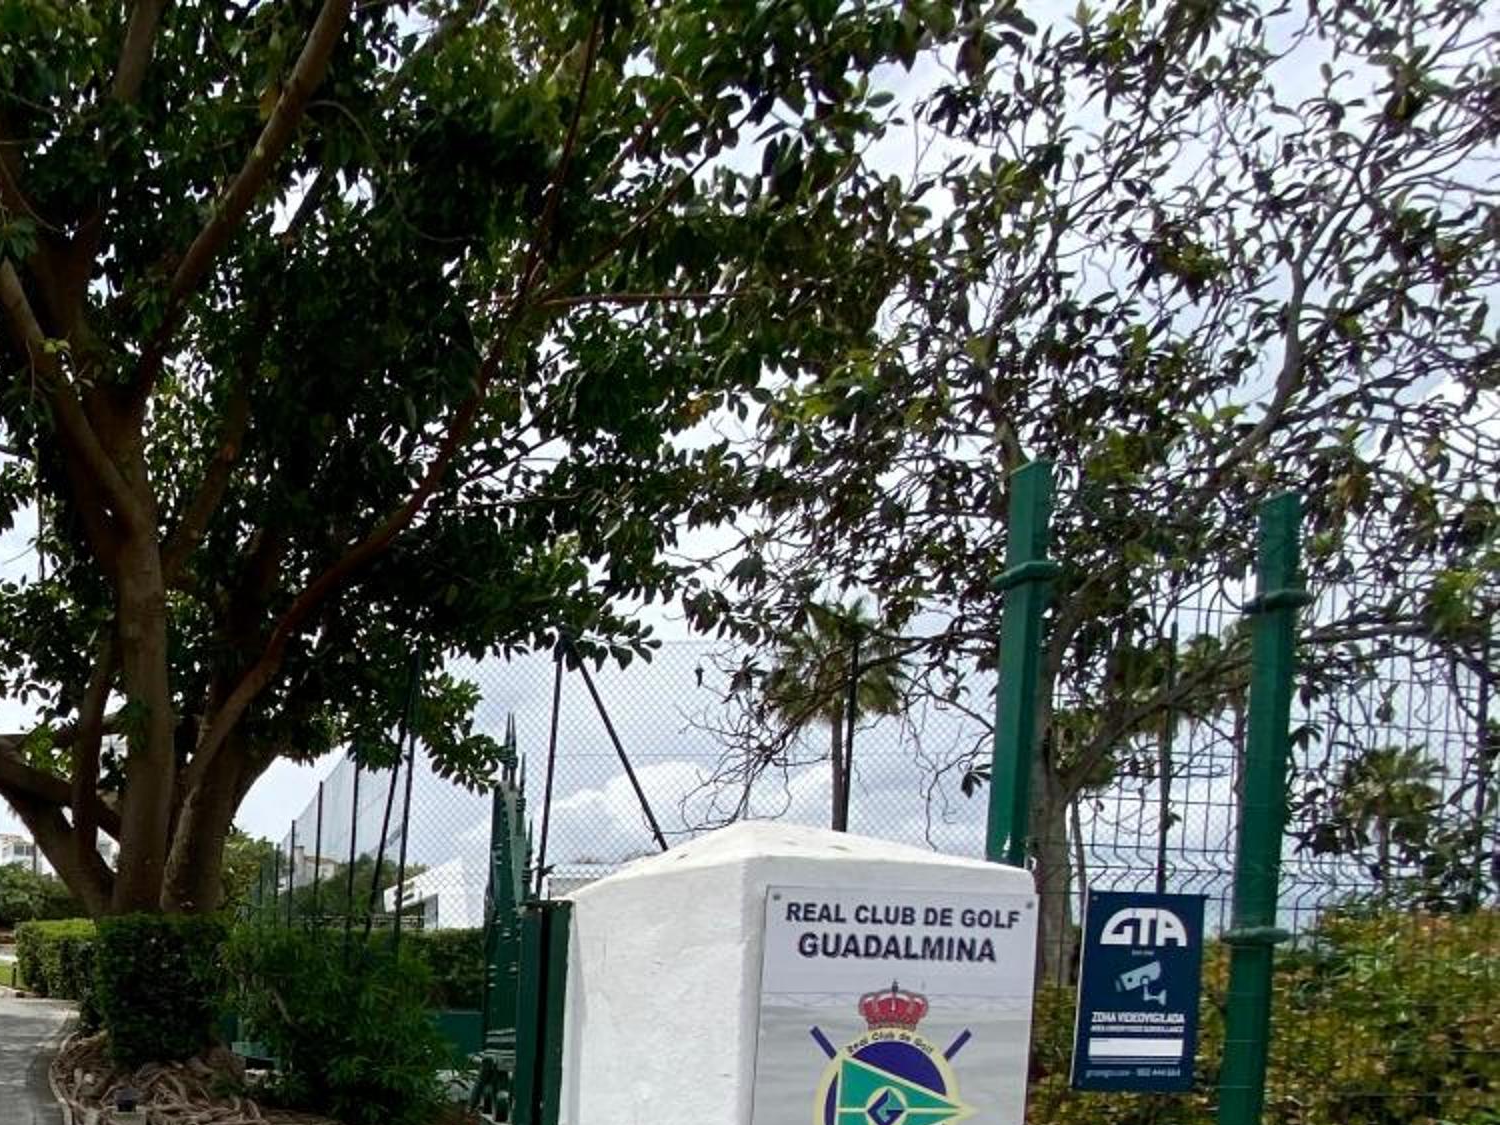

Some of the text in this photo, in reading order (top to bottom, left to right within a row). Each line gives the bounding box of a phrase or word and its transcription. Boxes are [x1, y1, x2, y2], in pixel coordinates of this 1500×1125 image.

[785, 902, 1020, 929] REAL CLUB DE GOLF
[1100, 907, 1188, 947] GTA
[798, 931, 997, 963] GUADALMINA
